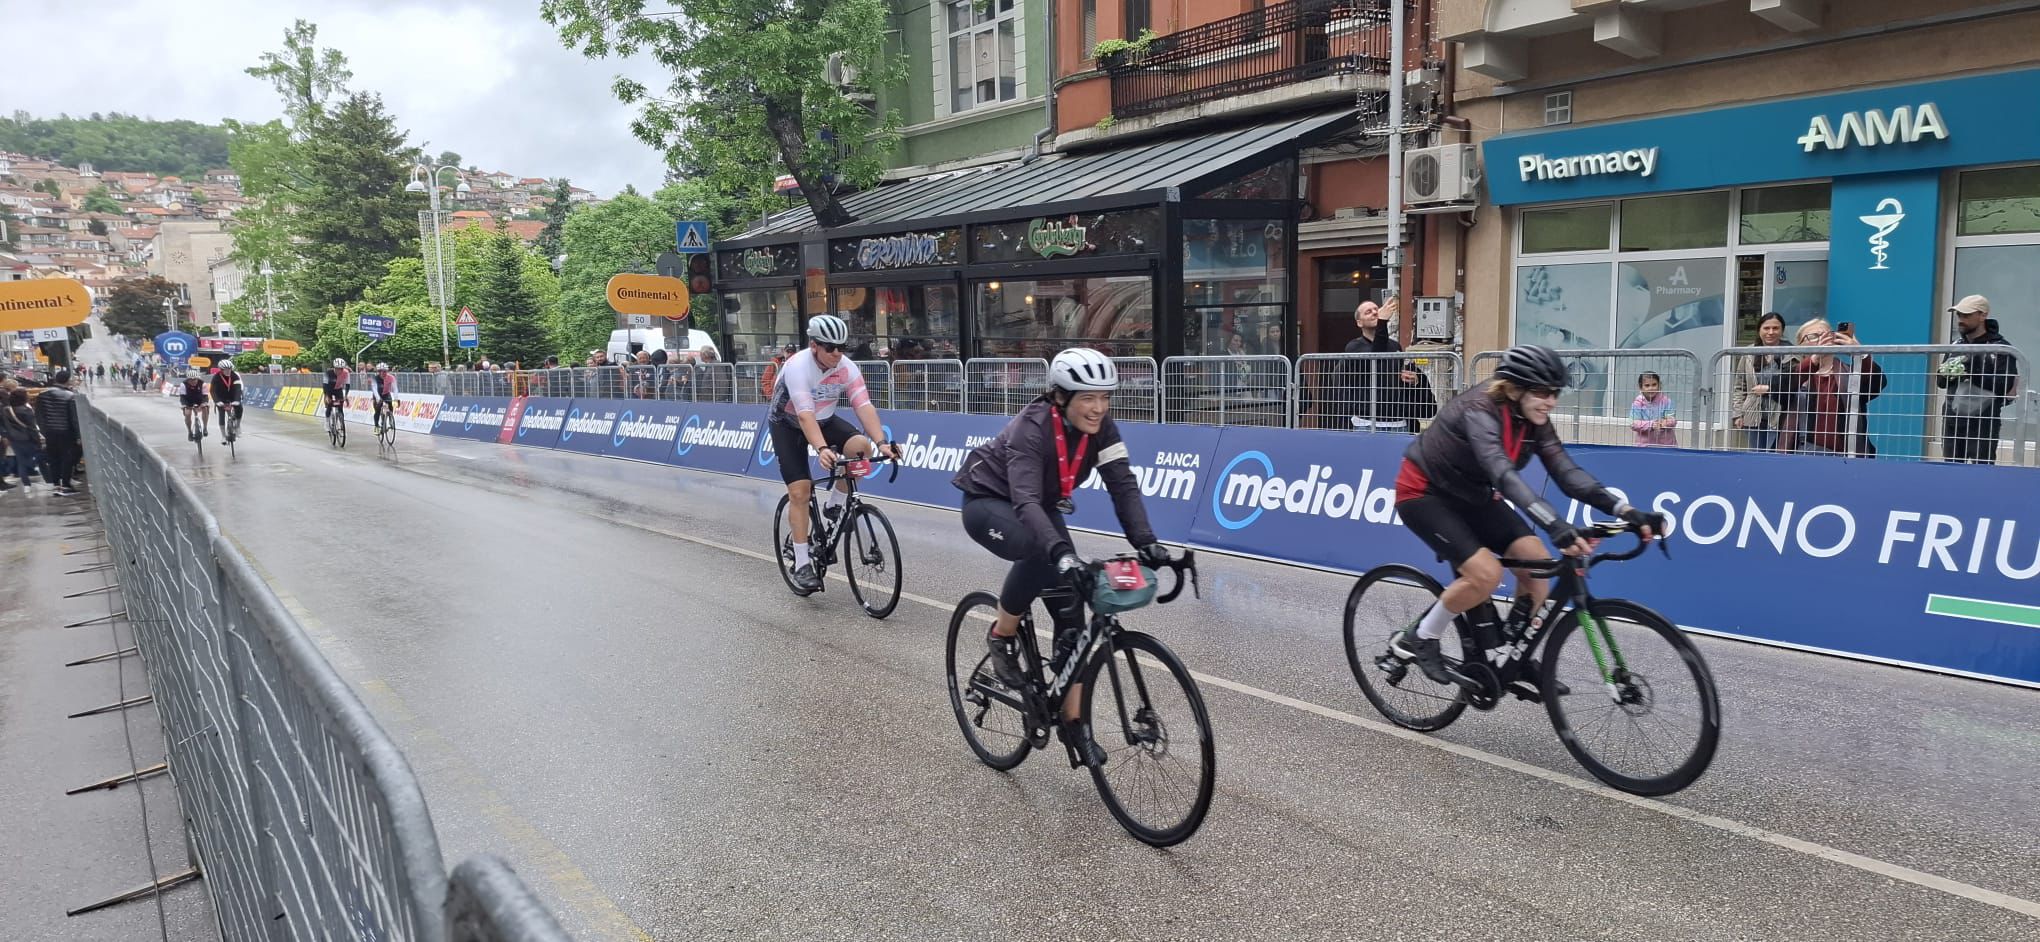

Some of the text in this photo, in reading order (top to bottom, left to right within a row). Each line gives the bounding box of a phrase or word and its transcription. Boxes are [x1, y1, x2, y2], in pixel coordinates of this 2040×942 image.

[1518, 147, 1658, 182] Pharmacy
[1028, 216, 1086, 259] Carlsberg
[617, 287, 671, 301] Continental
[1656, 287, 1702, 296] Pharmacy
[43, 330, 58, 339] 50
[521, 410, 564, 431] mediolanum
[566, 412, 613, 436] mediolanum
[617, 415, 677, 441] mediolanum
[665, 416, 680, 424] BANCA
[741, 420, 758, 431] BANCA
[681, 419, 754, 450] mediolanum
[966, 435, 996, 448] BANC
[1155, 451, 1200, 468] BANCA
[1223, 464, 1404, 526] mediola
[1652, 491, 1856, 558] SONO
[1878, 510, 2040, 580] FRIU
